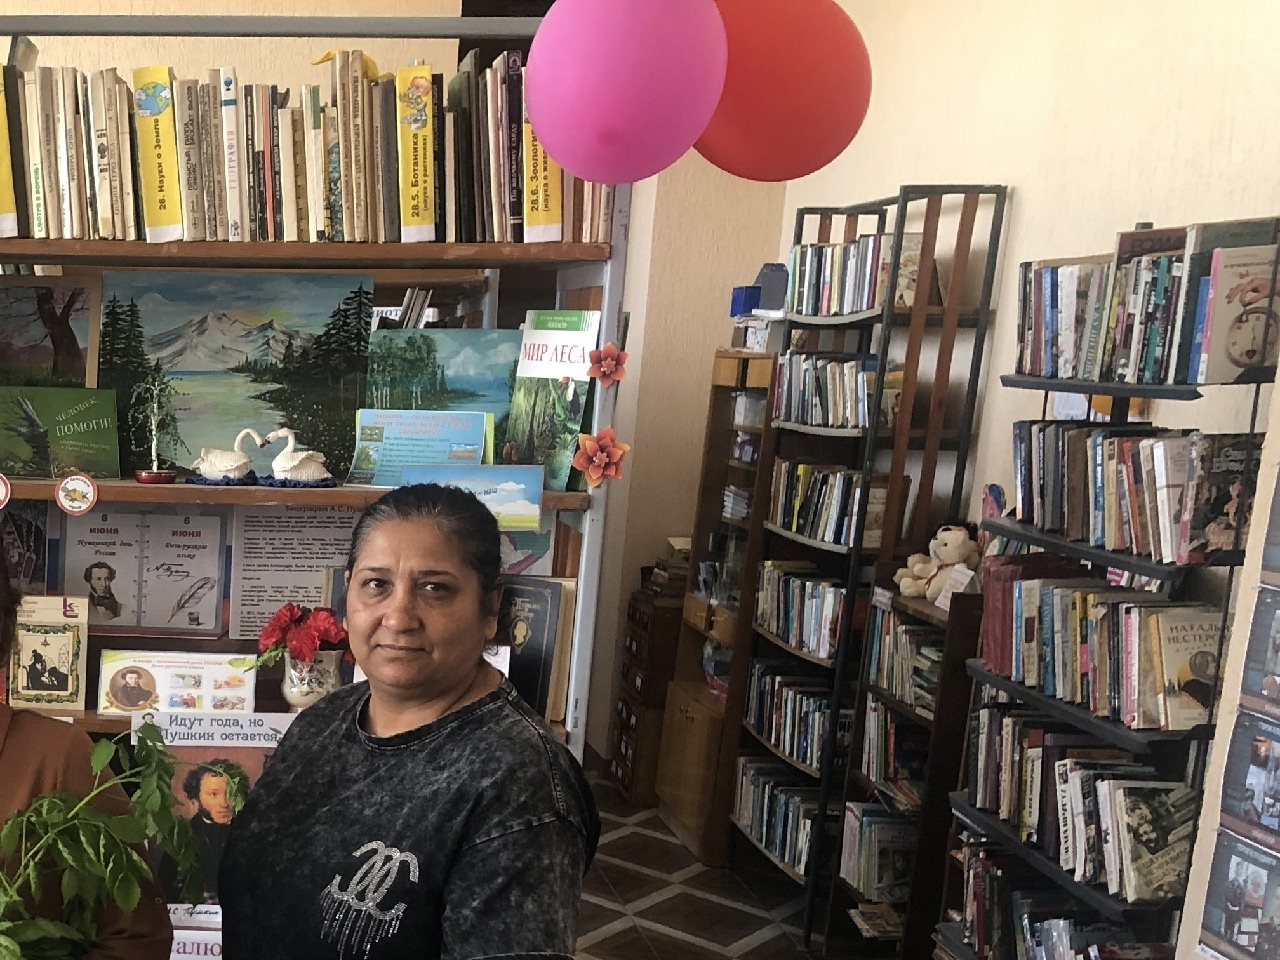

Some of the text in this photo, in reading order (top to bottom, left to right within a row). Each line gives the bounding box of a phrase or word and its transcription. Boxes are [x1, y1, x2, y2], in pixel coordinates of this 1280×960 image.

[153, 118, 163, 151] Земле
[156, 163, 166, 192] Науки
[410, 133, 420, 217] 28.5. Ботаника
[530, 185, 539, 211] 28.6.
[521, 342, 586, 364] МИР ЛЕСА
[56, 418, 113, 437] ПОМОГИ!
[101, 514, 108, 522] 6
[183, 517, 191, 525] 6
[169, 715, 264, 730] Идут года, но
[161, 729, 215, 743] Пушкин
[175, 941, 222, 957] алю
